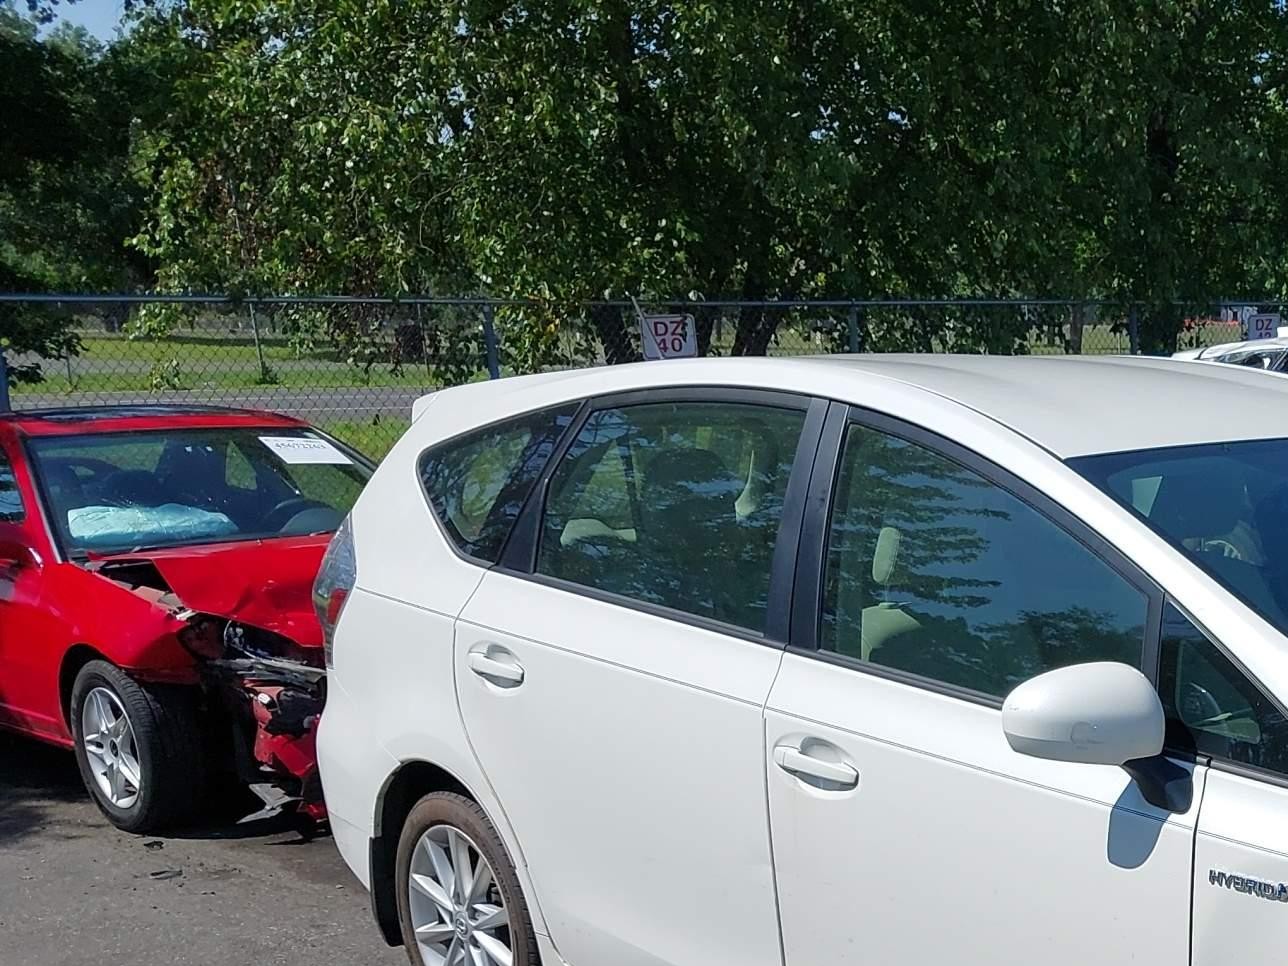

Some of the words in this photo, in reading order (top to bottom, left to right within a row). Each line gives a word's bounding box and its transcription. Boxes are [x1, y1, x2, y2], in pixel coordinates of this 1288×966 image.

[653, 320, 684, 337] DZ
[1255, 318, 1273, 331] DZ
[658, 337, 683, 353] 40
[1208, 869, 1278, 901] HYBRID
